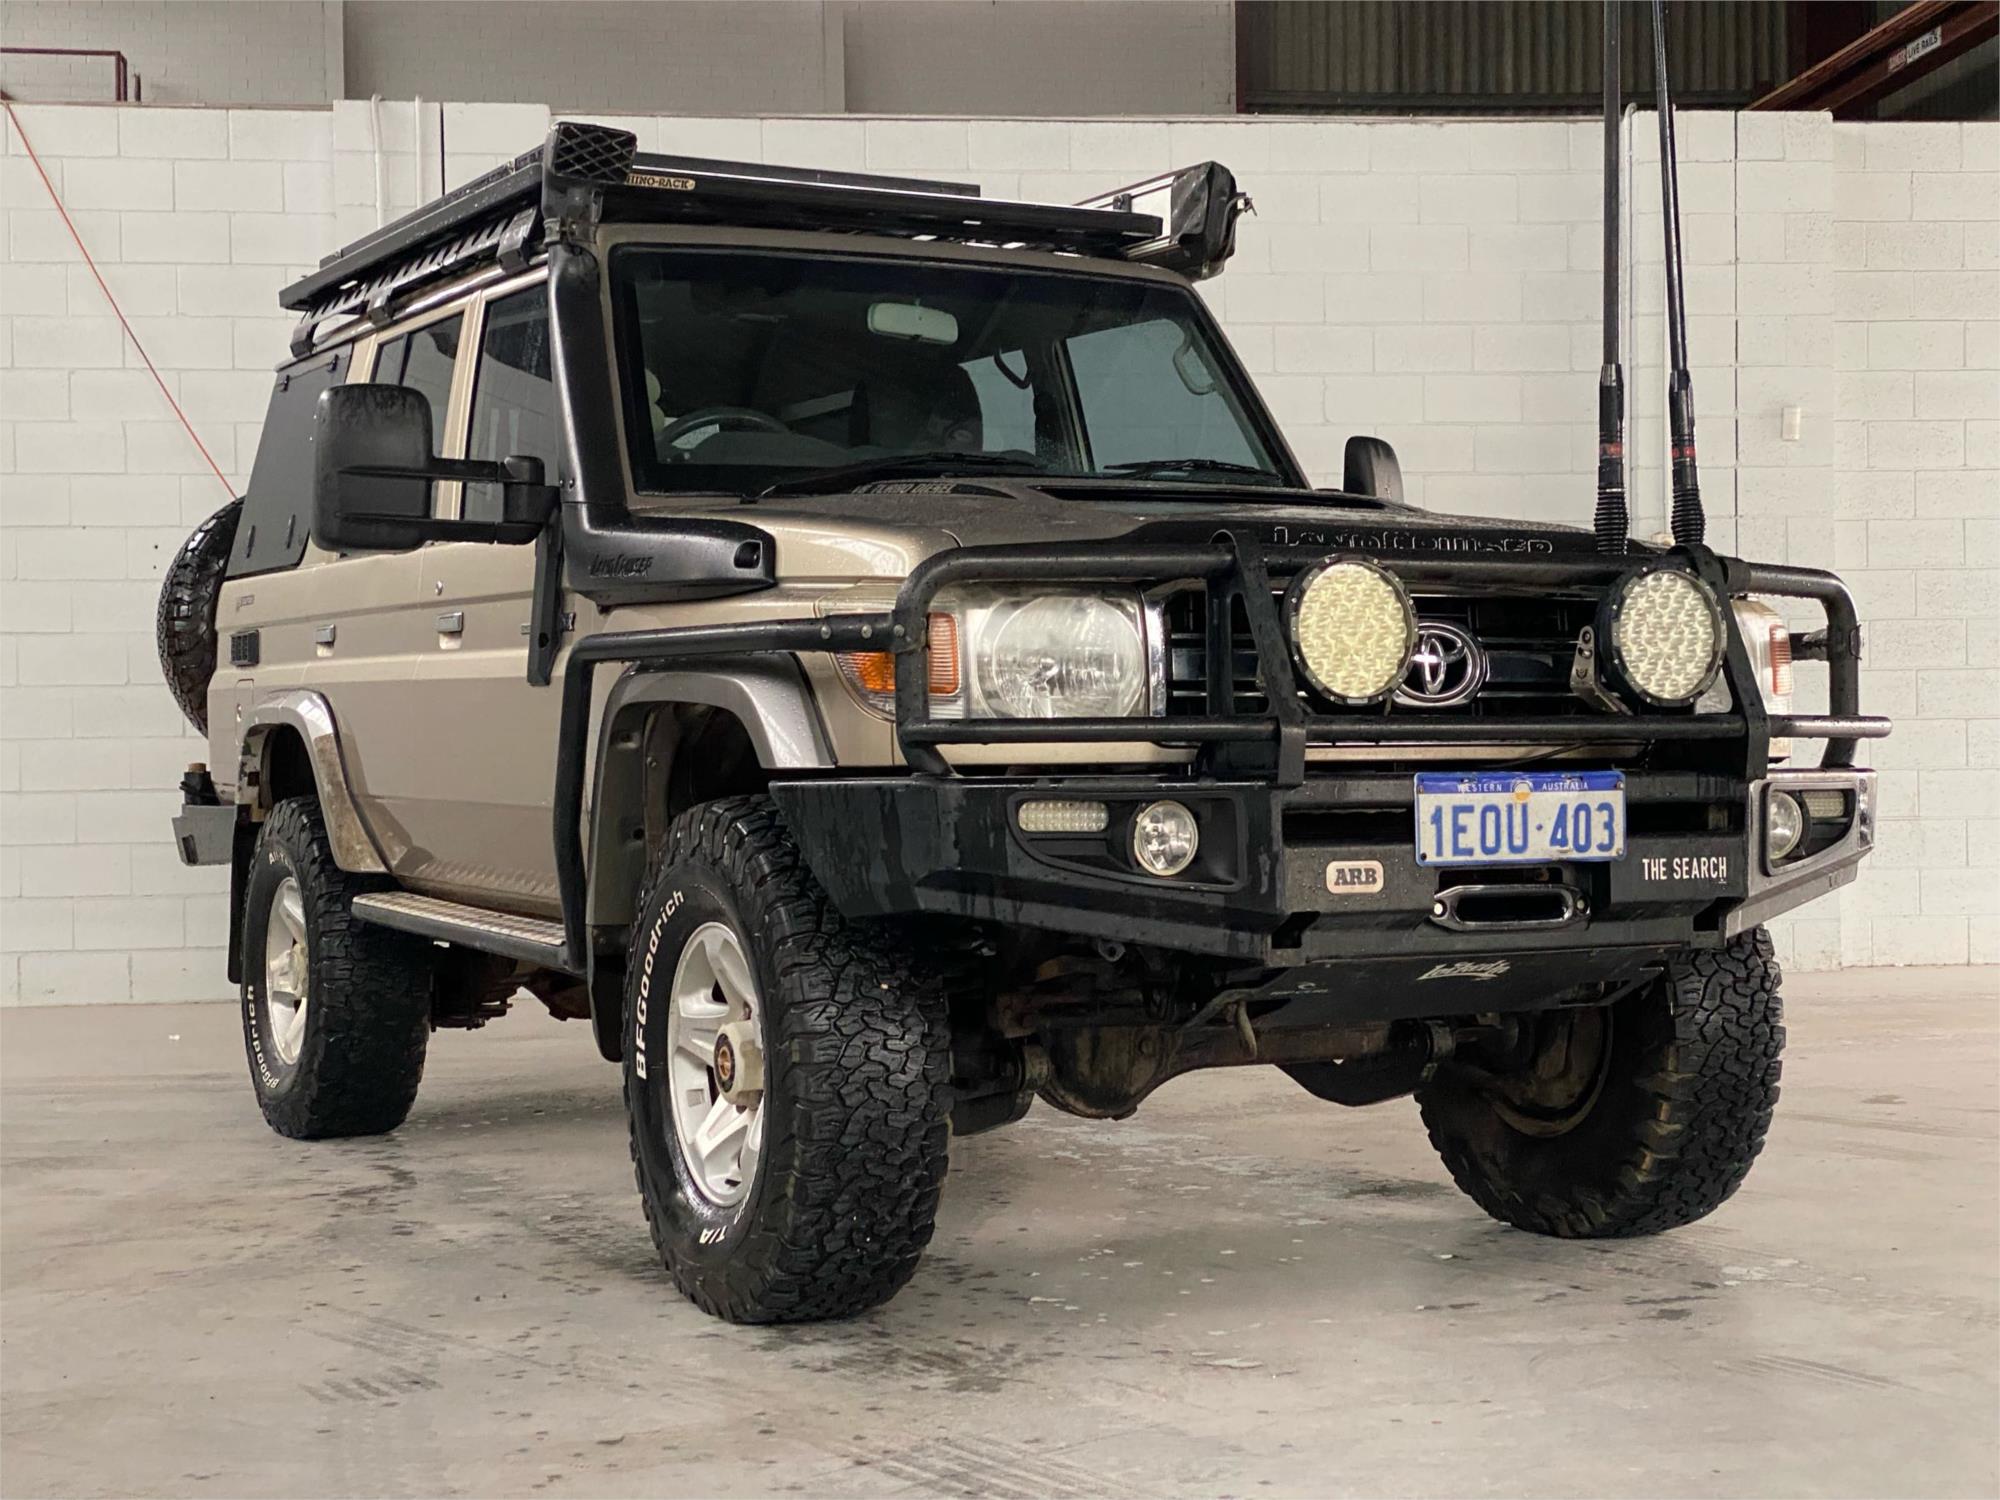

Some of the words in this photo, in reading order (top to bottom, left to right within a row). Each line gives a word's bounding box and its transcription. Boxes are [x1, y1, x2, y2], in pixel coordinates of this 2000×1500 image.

[626, 174, 690, 189] HINO-RACK
[1456, 783, 1502, 793] WESTERN
[1541, 781, 1589, 791] AUSTRALIA
[1334, 867, 1378, 886] ARB
[1641, 858, 1668, 881] THE
[1672, 856, 1727, 880] SEARCH
[636, 889, 685, 1080] BFGoodrich
[699, 1225, 728, 1244] T/A
